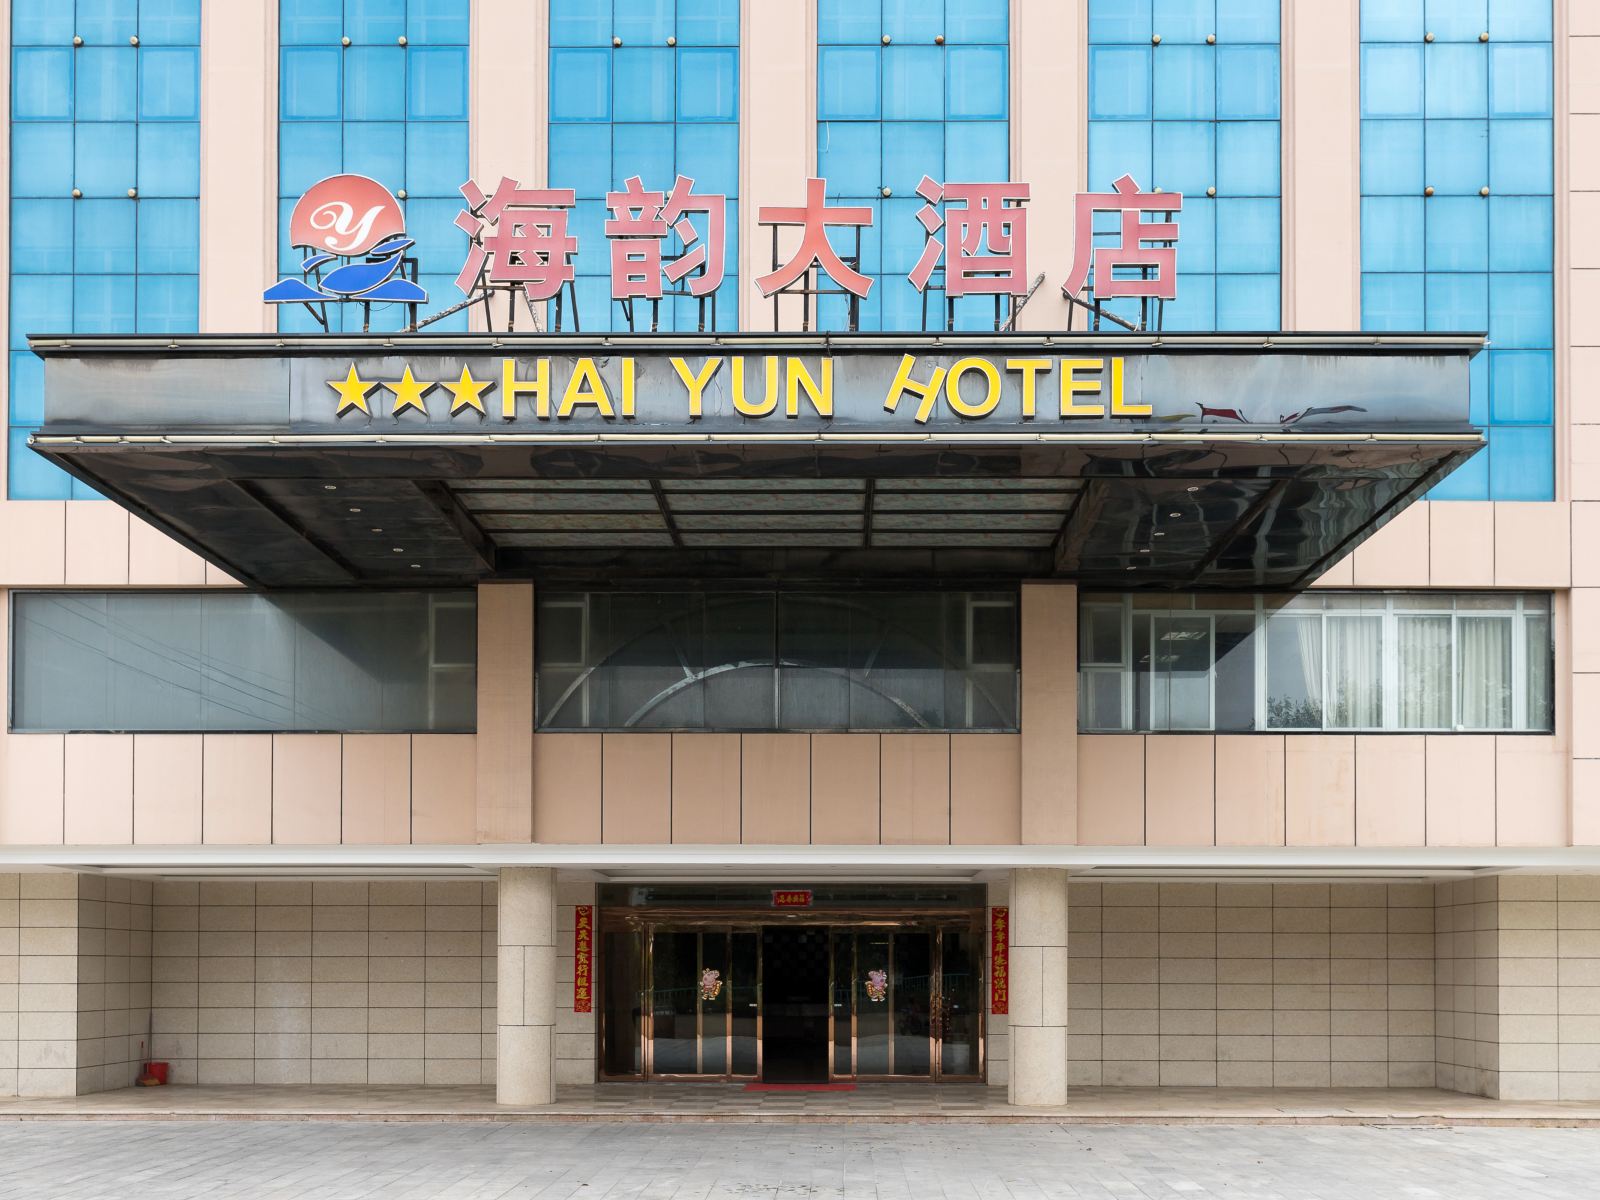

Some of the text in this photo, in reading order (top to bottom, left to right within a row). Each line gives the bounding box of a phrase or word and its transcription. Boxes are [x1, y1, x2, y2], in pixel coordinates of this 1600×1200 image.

[454, 173, 1183, 301] 海韵大酒店
[502, 353, 1153, 424] HAI YUN HOTEL
